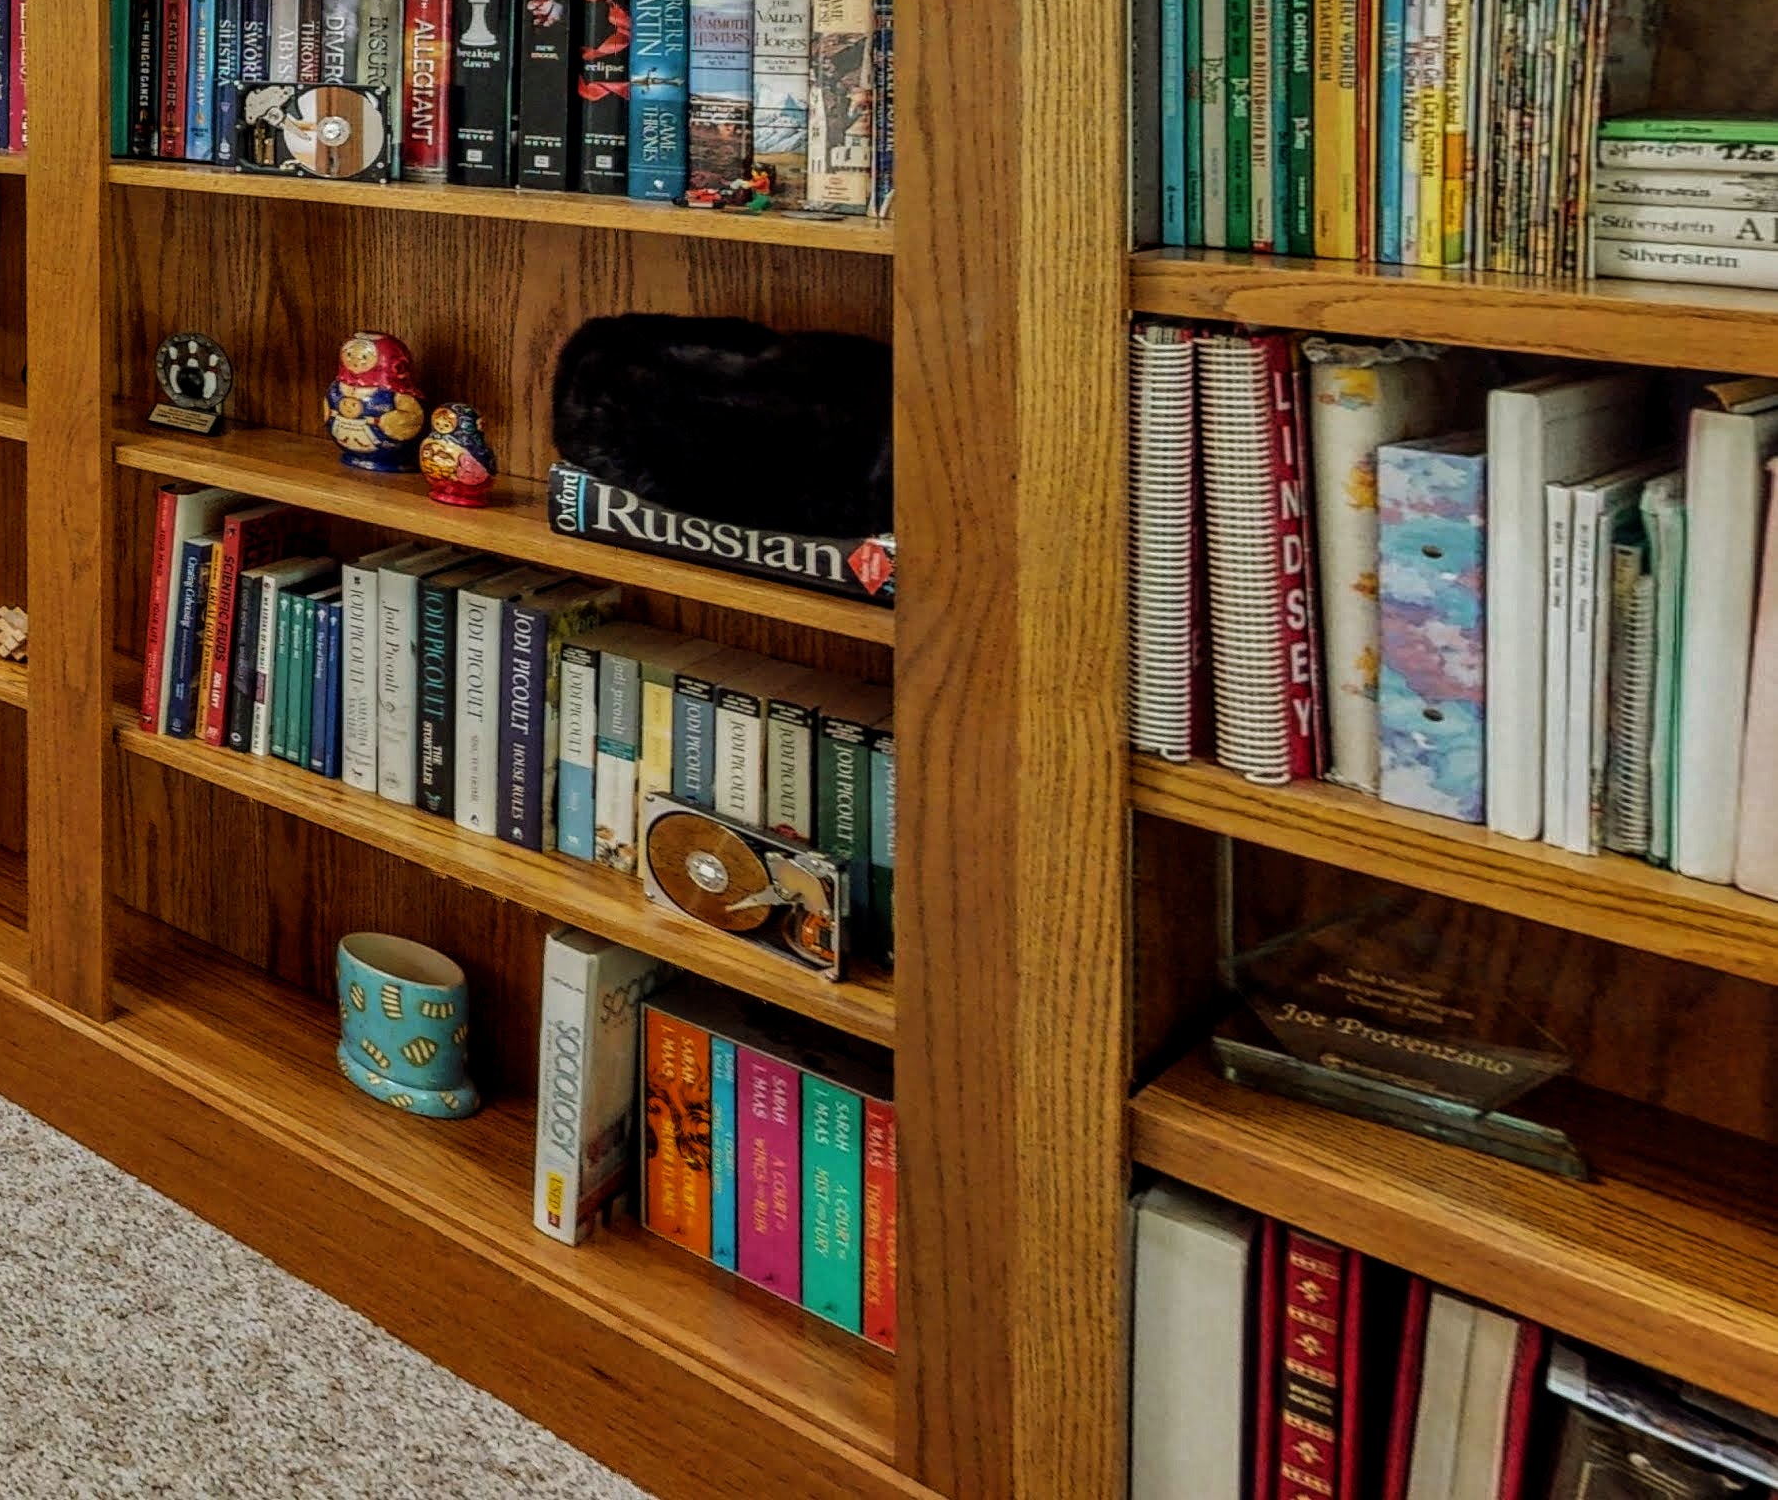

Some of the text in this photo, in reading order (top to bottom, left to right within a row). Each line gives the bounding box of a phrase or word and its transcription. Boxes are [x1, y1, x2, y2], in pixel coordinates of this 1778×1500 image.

[693, 31, 750, 47] HUNTERS
[757, 10, 805, 24] VALLEY
[1252, 35, 1266, 57] FOR
[1292, 12, 1307, 72] CHRISTMAS
[139, 35, 150, 106] HUNGER GAMES
[218, 20, 231, 86] SILISTRA
[412, 18, 436, 146] ALLEGIANT
[457, 49, 501, 61] breaking
[462, 58, 491, 68] dawn
[584, 62, 625, 80] eclipse
[1338, 31, 1353, 90] WORRIED
[642, 106, 658, 162] THRONES
[660, 113, 677, 152] GAME
[1715, 143, 1775, 161] The
[1617, 249, 1738, 268] Silverstein
[1736, 218, 1764, 241] A
[556, 469, 580, 531] Oxford
[593, 482, 846, 582] Russian
[1272, 369, 1314, 737] LINDSEY
[213, 554, 235, 661] SCIENTIFIC FEUDS
[348, 589, 364, 684] JODI PICOULT
[382, 606, 399, 693] Jodi Picoult
[421, 590, 446, 719] JODI PICOULT
[465, 602, 486, 722] JODI PICOULT
[509, 609, 534, 734] JODI PICOULT
[567, 670, 583, 755] JODI PICOULT
[608, 659, 626, 734] jodi picoult
[421, 721, 433, 784] STORYTELLER
[433, 744, 442, 765] THE
[682, 701, 703, 791] JODI PICOULT
[727, 720, 746, 809] JODI PICOULT
[776, 727, 798, 820] JODI PICOULT
[510, 743, 525, 819] HOUSE RULES
[831, 744, 855, 842] JODI PICOULT
[661, 1037, 675, 1079] MAAS
[681, 1036, 695, 1085] SARAH
[1274, 1002, 1327, 1028] Joe
[1335, 1016, 1513, 1075] Provenzano
[551, 1019, 581, 1159] SOCIOLOGY
[751, 1076, 768, 1120] MAAS
[771, 1074, 788, 1126] SARAH
[813, 1100, 829, 1146] MAAS
[834, 1100, 851, 1154] SARAH
[868, 1126, 885, 1169] MAAS
[753, 1136, 768, 1236] WINGS RUIN
[772, 1169, 788, 1226] COURT
[814, 1165, 829, 1260] MIST FURY
[834, 1198, 851, 1250] COURT
